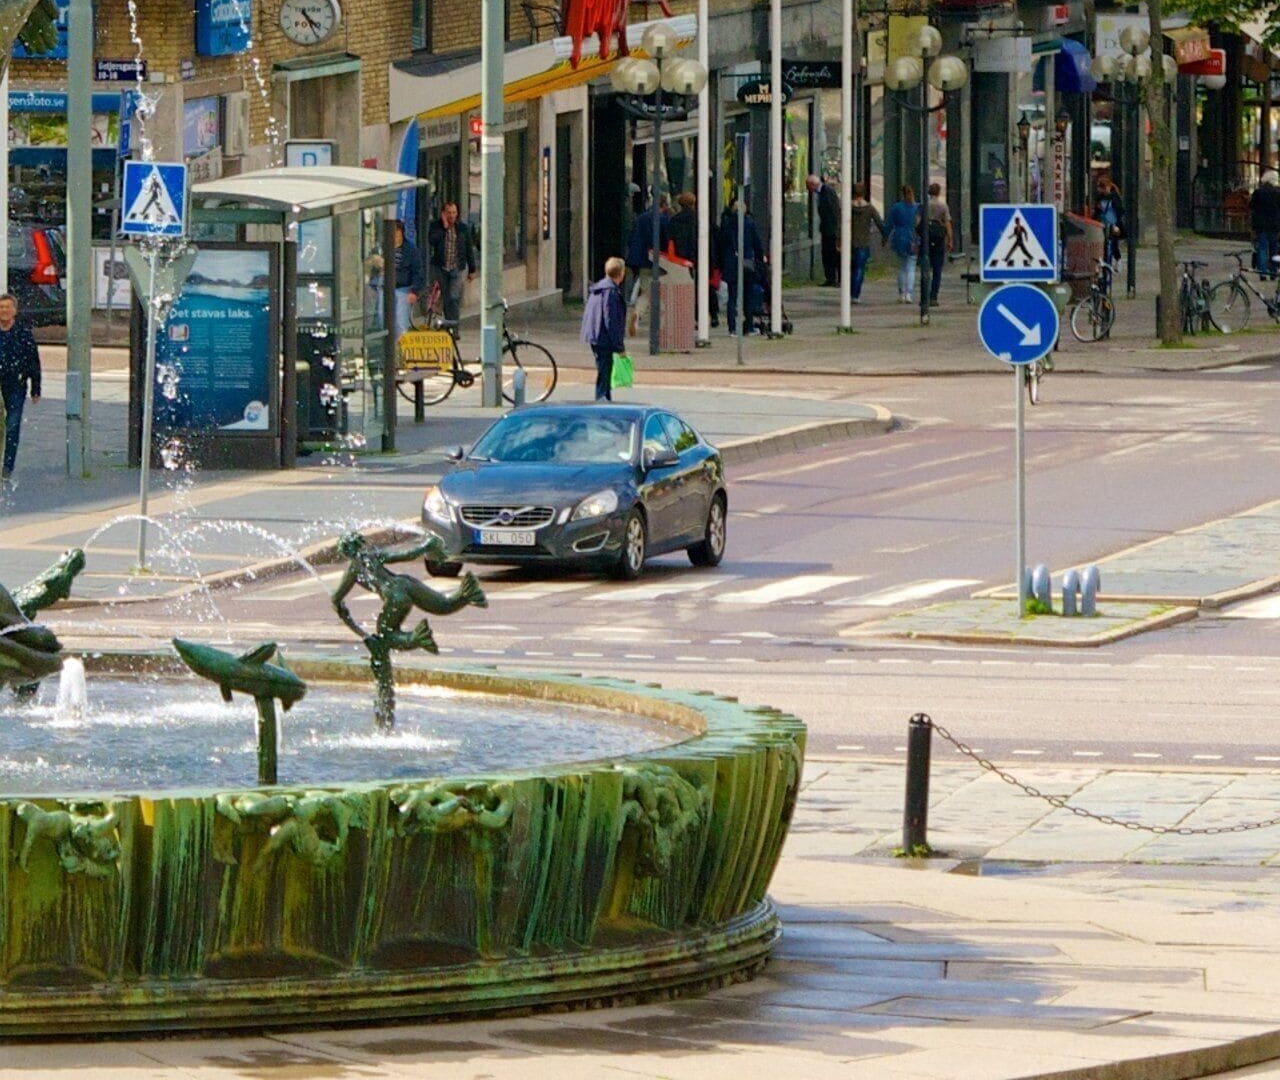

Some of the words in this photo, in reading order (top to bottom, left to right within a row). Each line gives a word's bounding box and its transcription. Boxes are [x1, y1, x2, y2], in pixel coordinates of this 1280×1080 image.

[191, 309, 226, 319] stavas
[228, 308, 253, 319] laks.
[483, 531, 502, 543] SKL
